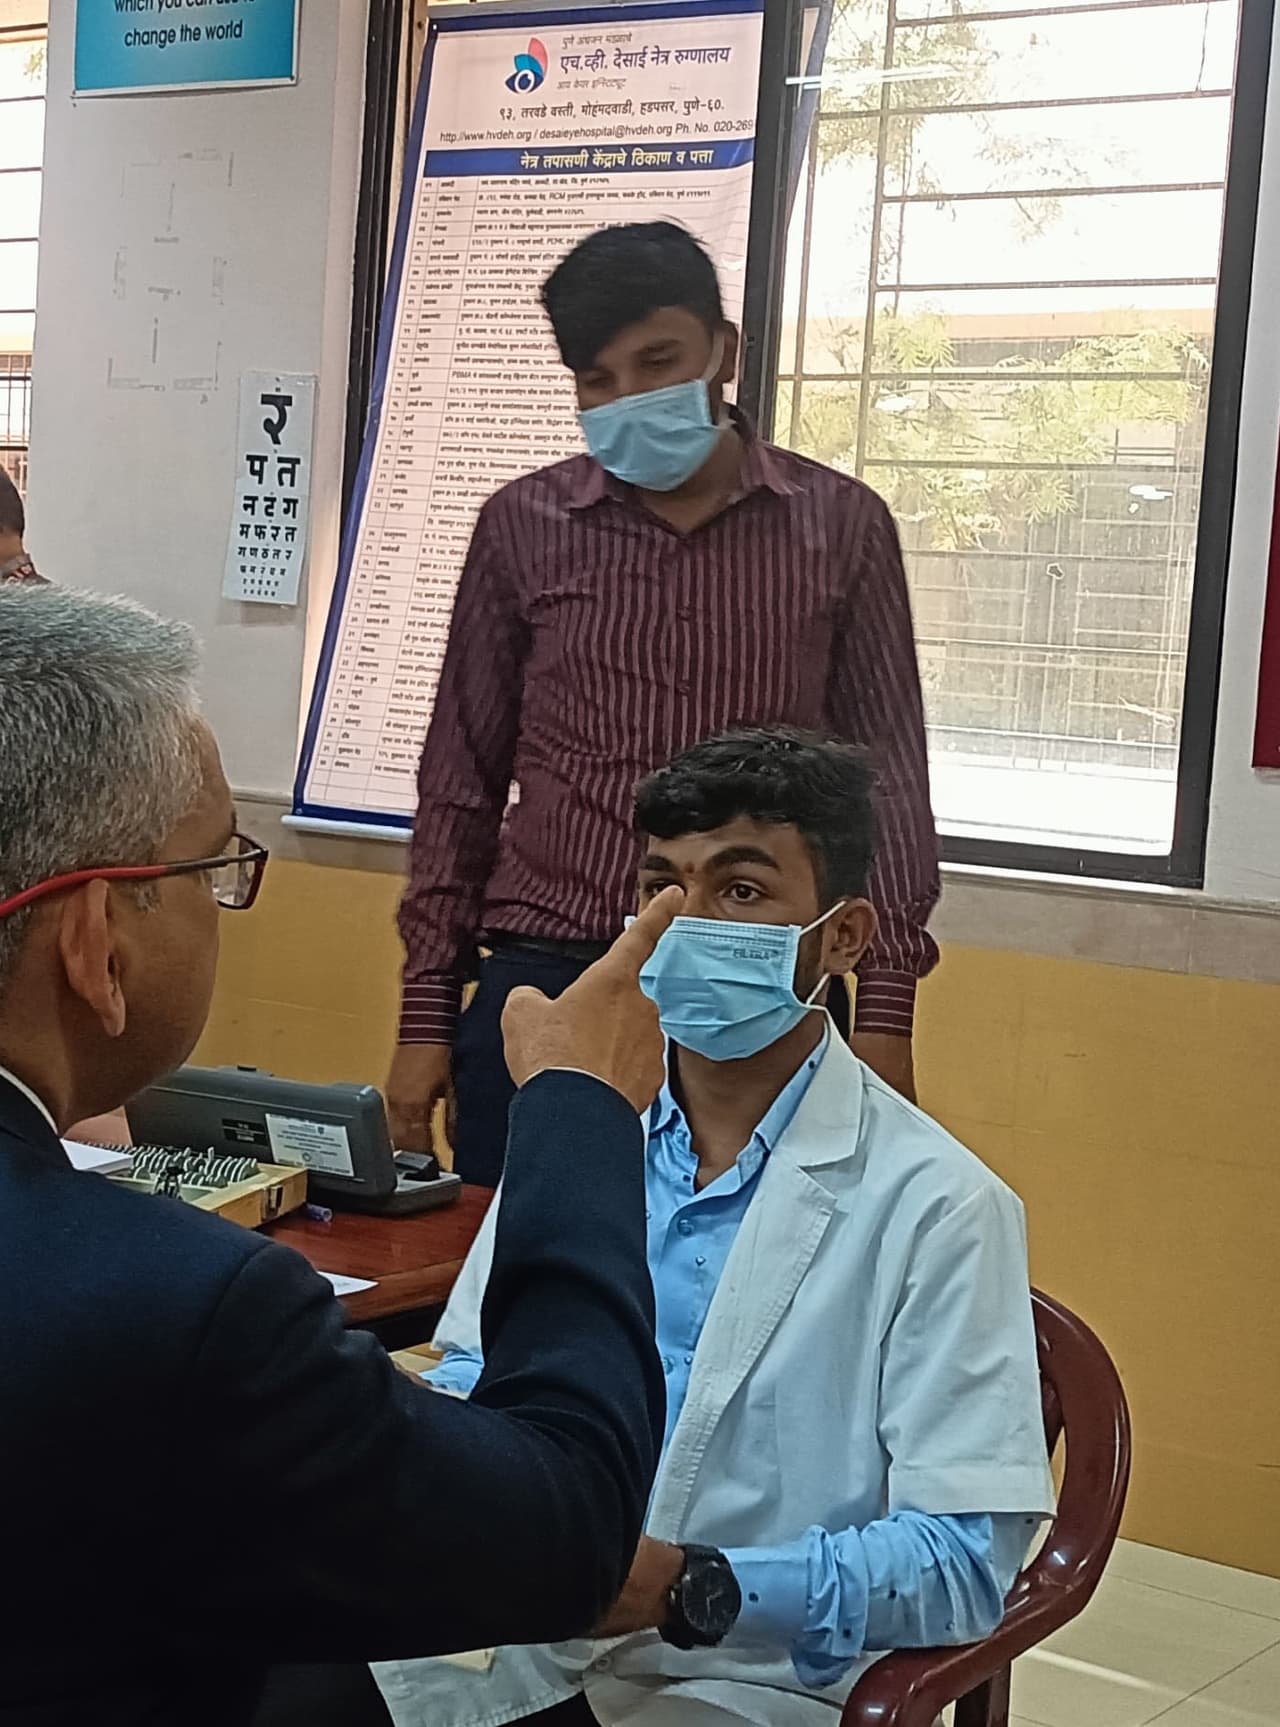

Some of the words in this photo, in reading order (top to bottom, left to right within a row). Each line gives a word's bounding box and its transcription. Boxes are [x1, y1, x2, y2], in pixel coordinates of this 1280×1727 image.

[114, 0, 154, 12] which
[158, 0, 181, 13] you
[124, 28, 176, 49] change
[180, 23, 201, 42] the
[205, 19, 243, 40] world
[614, 46, 648, 69] देसाई
[650, 45, 671, 66] नेत्र
[675, 47, 731, 65] रुग्णालय
[521, 150, 540, 169] नेत्र
[543, 148, 589, 169] तपासणी
[592, 147, 628, 169] केंद्राचे
[676, 151, 685, 164] व
[690, 149, 714, 165] पत्ता
[260, 393, 293, 445] र
[246, 454, 268, 484] प
[277, 456, 301, 487] त
[242, 495, 258, 516] न
[282, 497, 299, 519] ग
[239, 523, 250, 539] म
[254, 524, 267, 541] फ
[270, 525, 281, 541] र
[284, 526, 297, 542] त
